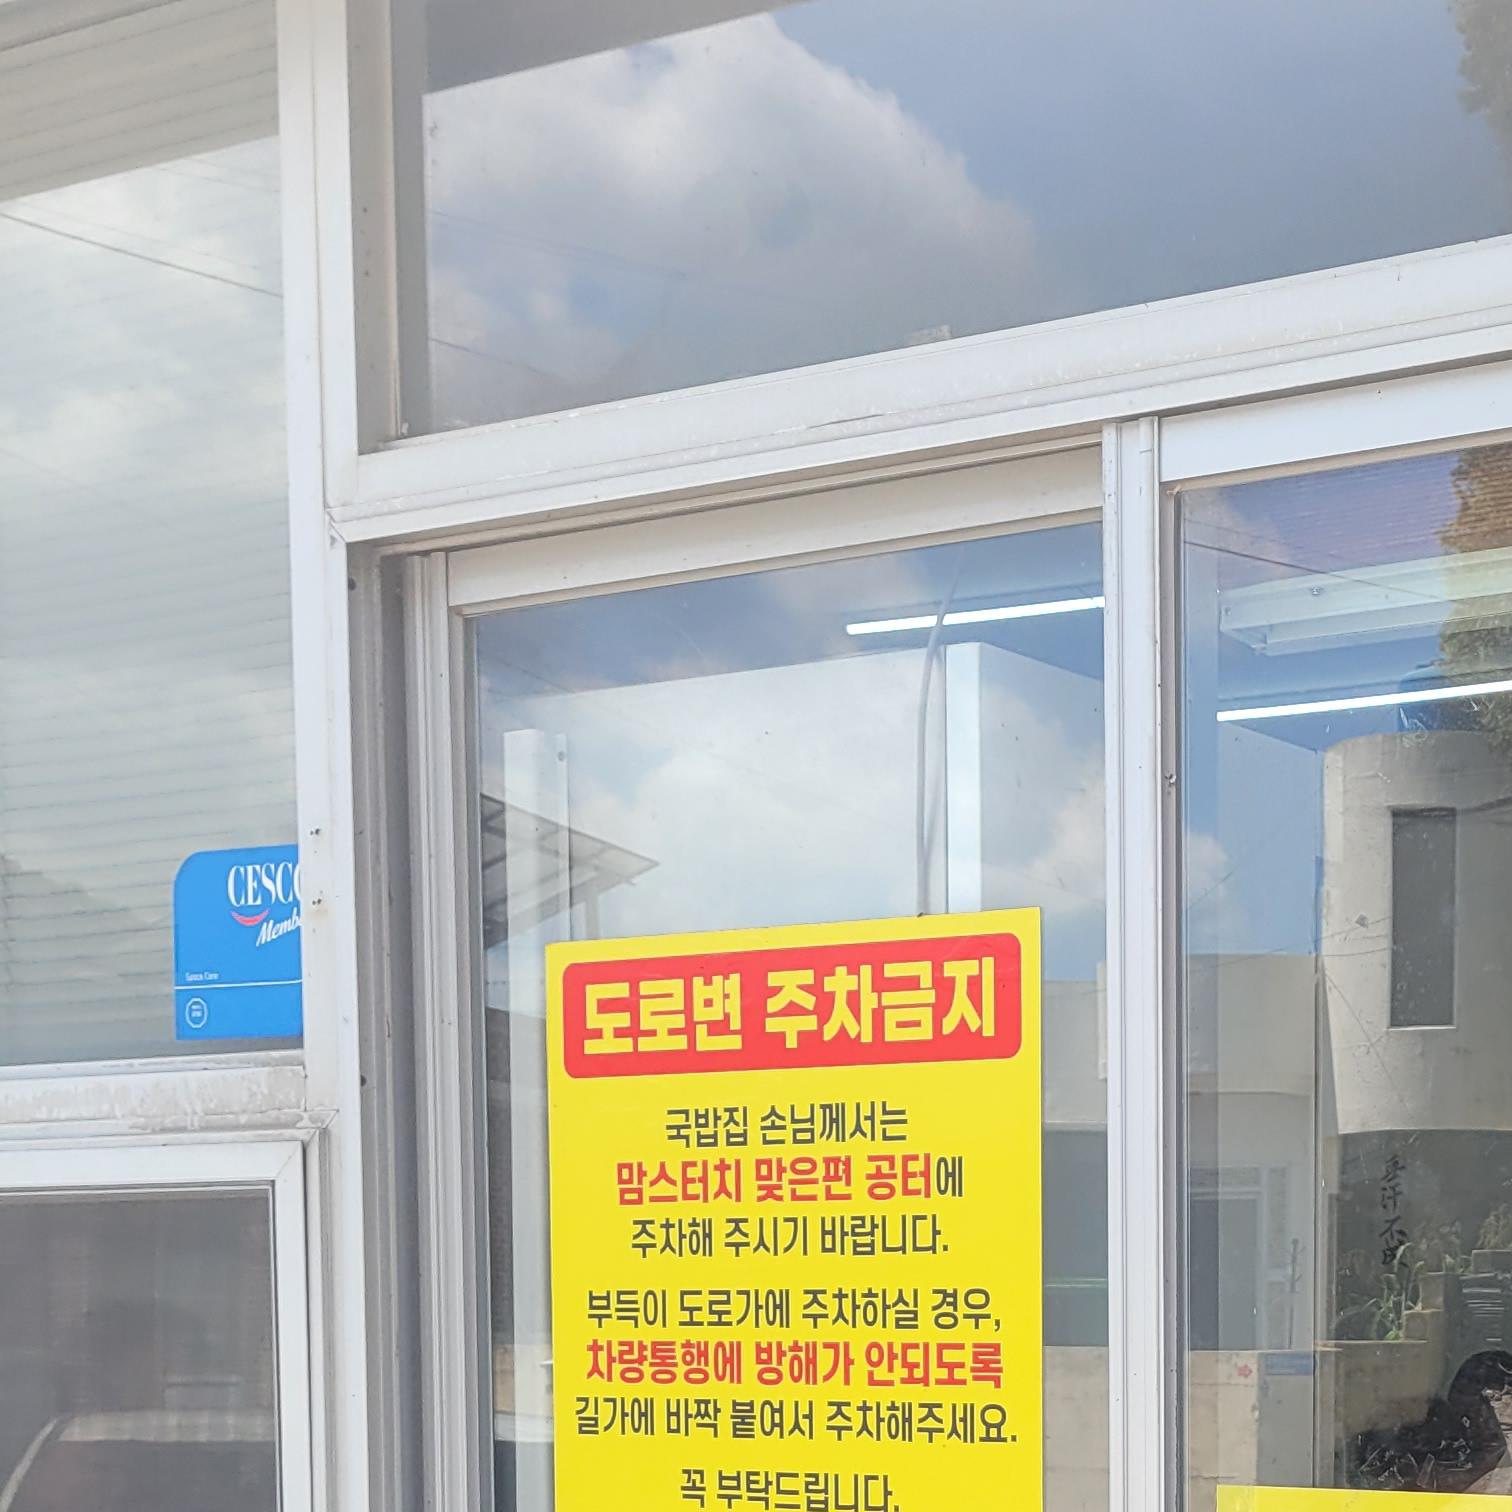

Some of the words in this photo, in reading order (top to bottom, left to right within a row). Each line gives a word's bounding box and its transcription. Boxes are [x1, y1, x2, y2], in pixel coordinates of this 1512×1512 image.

[584, 974, 742, 1054] 도로변
[766, 957, 994, 1048] 주차금지
[666, 1107, 747, 1148] 국밥집
[761, 1101, 907, 1145] 손님께서는
[617, 1158, 741, 1205] 맘스터치
[756, 1156, 851, 1202] 맞은편
[866, 1153, 962, 1200] 공터에
[632, 1218, 712, 1258] 주차해
[725, 1217, 807, 1257] 주시기
[821, 1214, 948, 1255] 바랍니다.
[588, 1290, 666, 1328] 부득이
[679, 1289, 789, 1328] 도로가에
[803, 1288, 918, 1329] 주차하실
[932, 1289, 1000, 1331] 경우,
[587, 1339, 741, 1384] 차량통행에
[756, 1340, 854, 1385] 방해가
[865, 1342, 1003, 1388] 안되도록
[576, 1397, 654, 1435] 길가에
[667, 1399, 721, 1437] 바짝
[731, 1400, 813, 1439] 붙여서
[827, 1400, 1016, 1443] 주차해주세요.
[681, 1469, 706, 1508] 꼭
